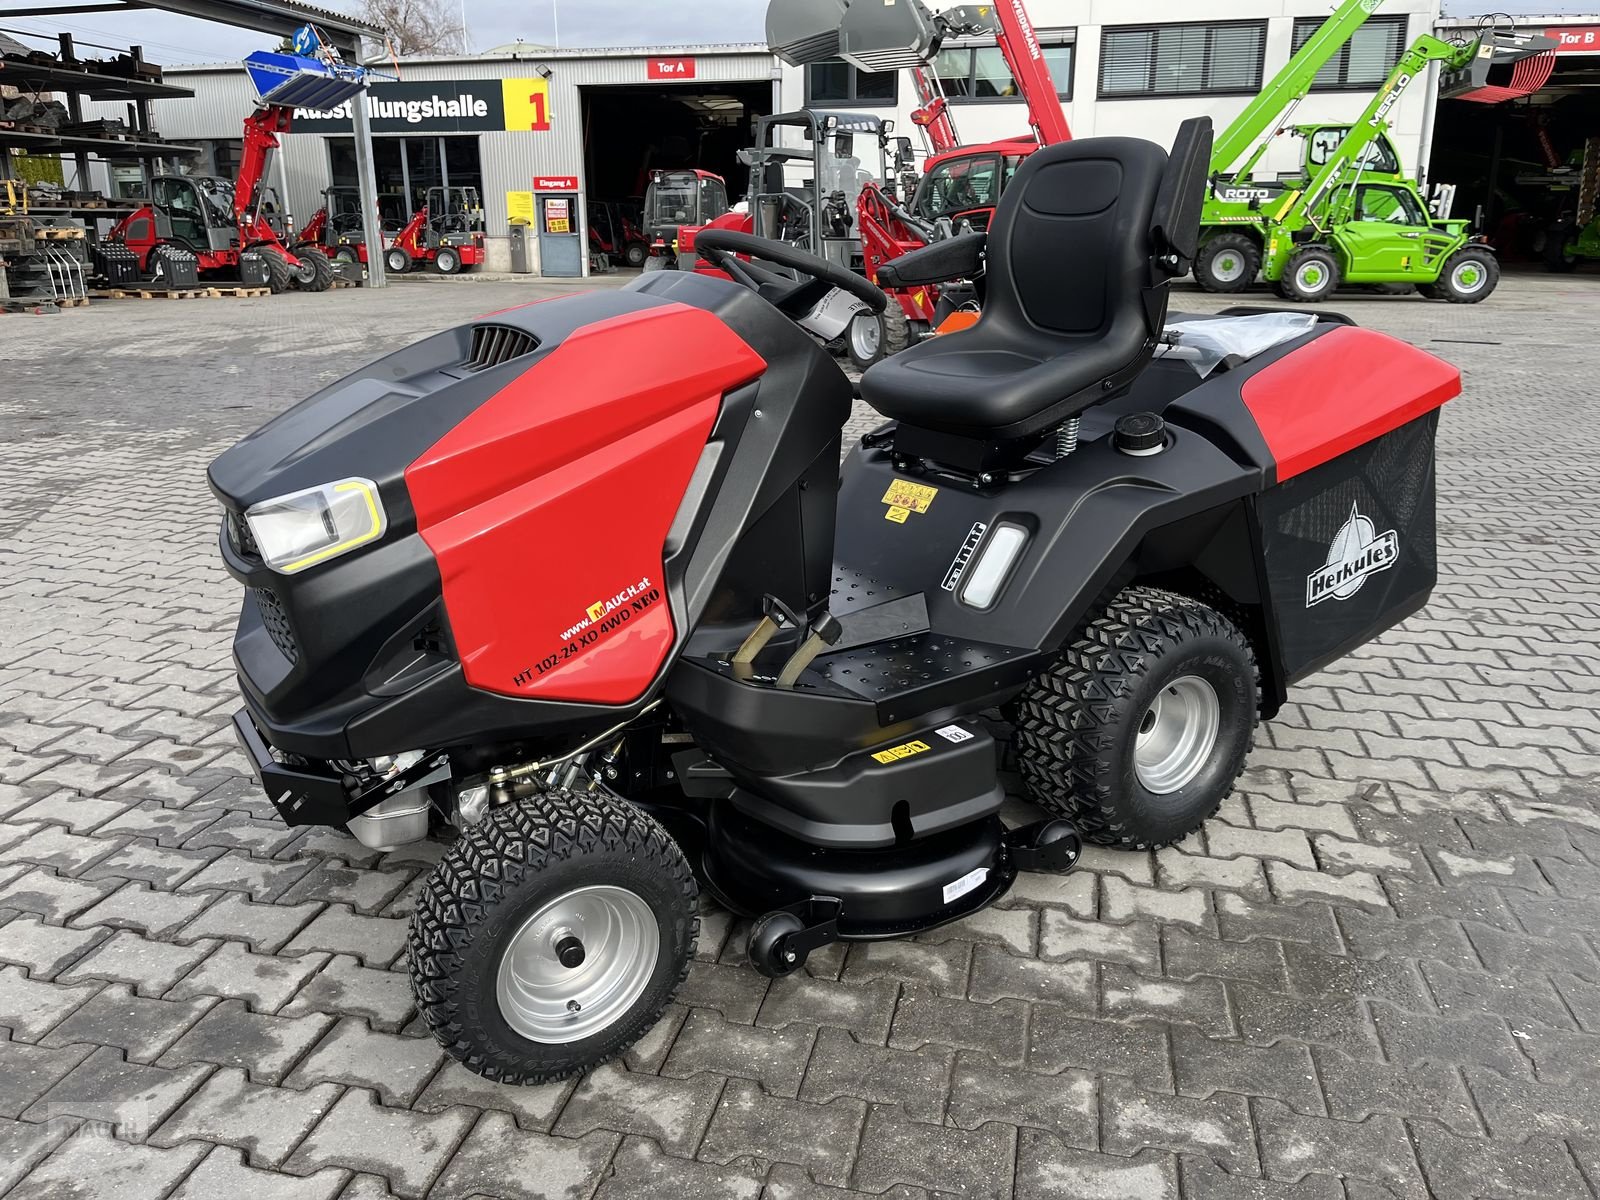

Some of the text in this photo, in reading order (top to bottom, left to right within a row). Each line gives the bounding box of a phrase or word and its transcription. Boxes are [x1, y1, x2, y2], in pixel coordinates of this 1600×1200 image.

[1559, 32, 1595, 44] Tor B
[657, 61, 685, 73] Tor A
[293, 94, 487, 123] Ausstllungshalle
[529, 92, 550, 132] 1
[1368, 73, 1411, 127] MERLO
[539, 179, 572, 188] Eingang A
[1225, 188, 1269, 199] ROTO
[1311, 543, 1394, 598] Herkules
[560, 576, 651, 641] www.MAUCH.at
[512, 588, 660, 687] HT 102-24 XD 4WD NEO
